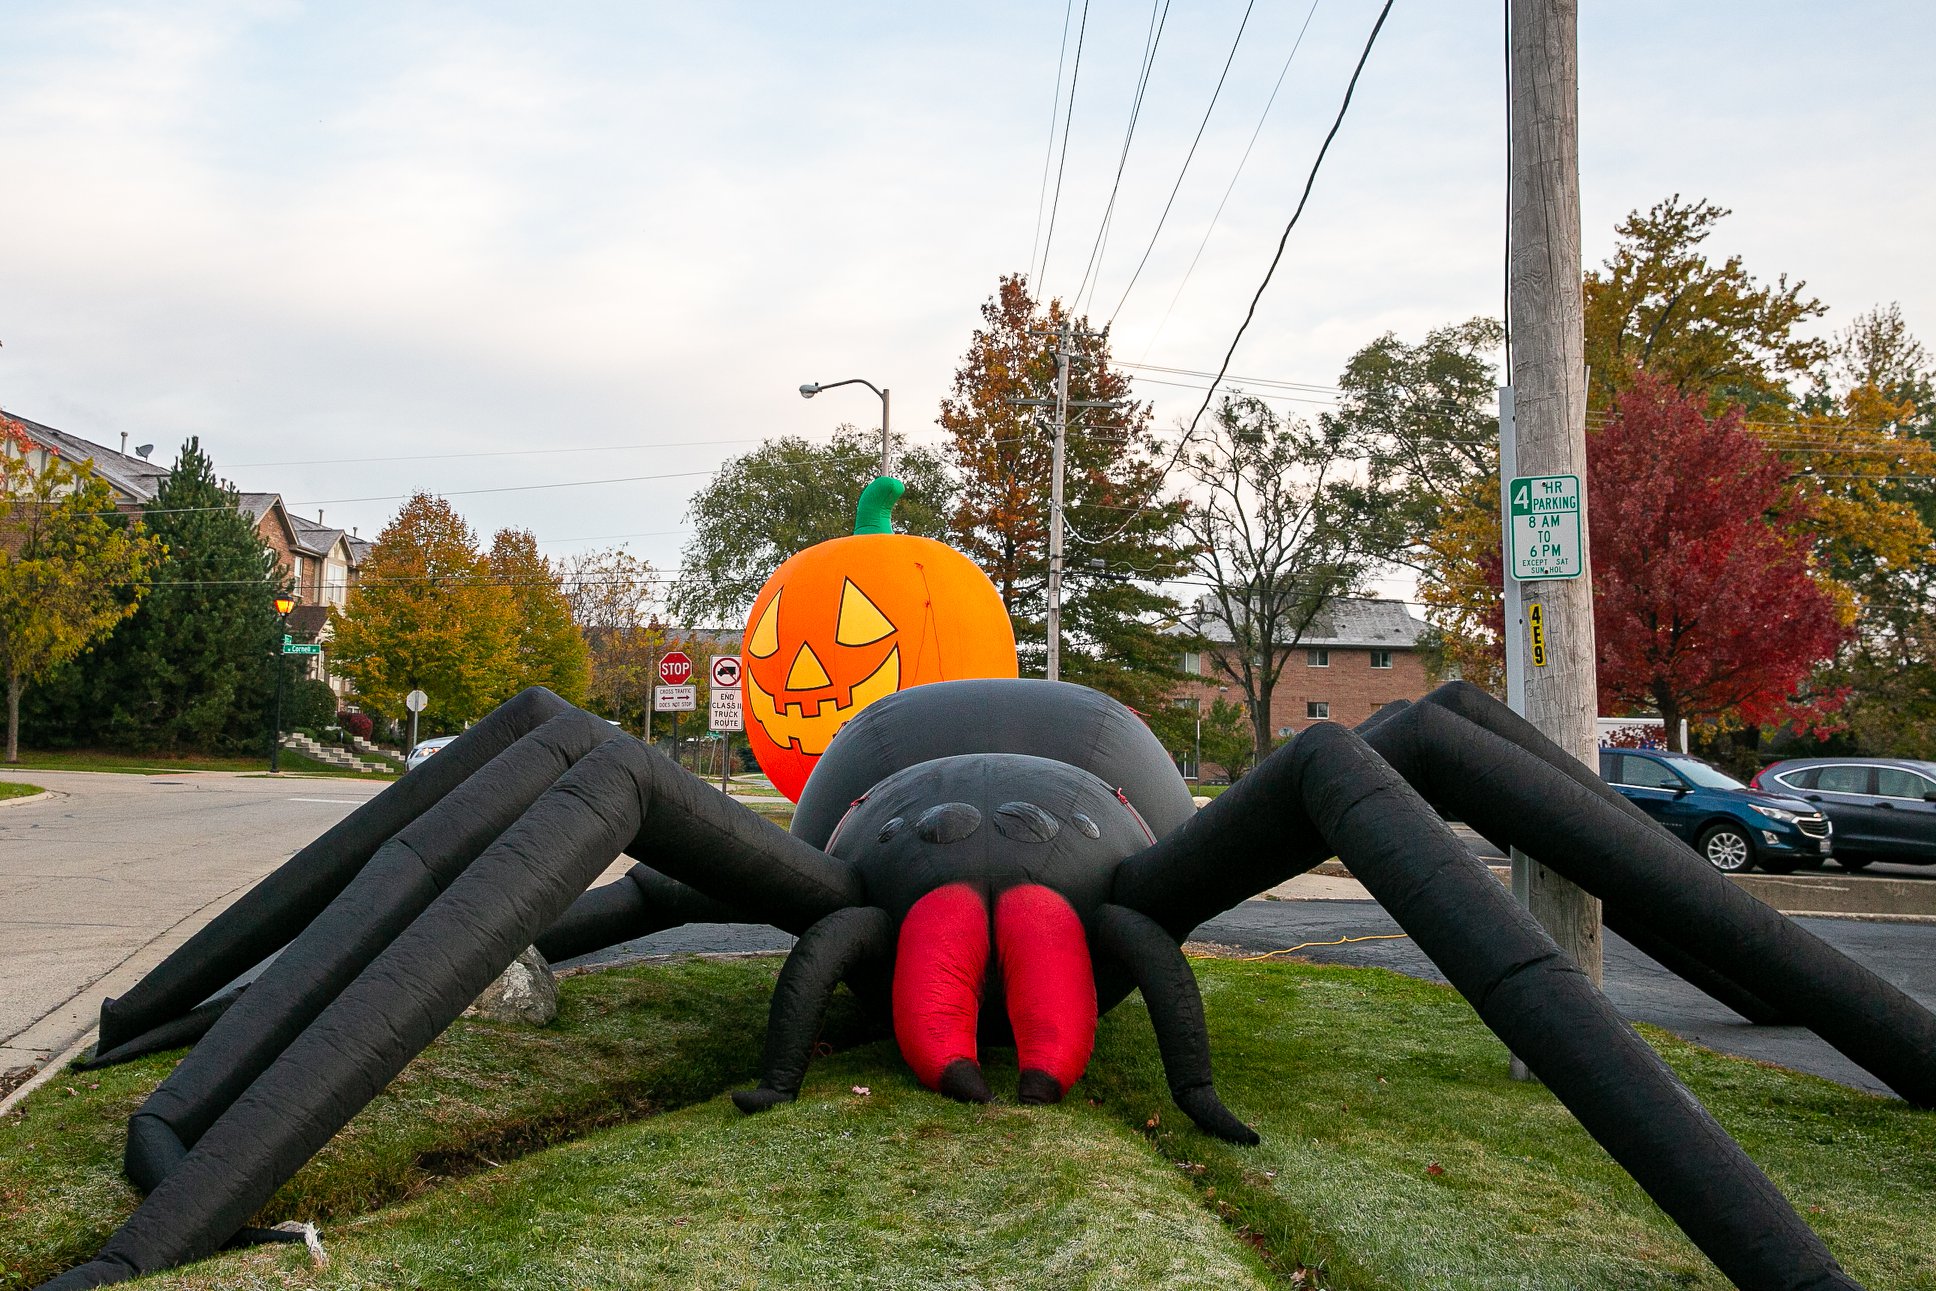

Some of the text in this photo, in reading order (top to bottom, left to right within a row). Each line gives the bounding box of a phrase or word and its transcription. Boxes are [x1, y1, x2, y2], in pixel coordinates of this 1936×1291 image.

[1513, 481, 1562, 510] 4 HR
[1533, 496, 1576, 511] PARKING
[1528, 515, 1560, 528] 8 AM
[1538, 530, 1551, 543] TO
[1530, 544, 1561, 558] 6 PM
[1522, 559, 1548, 567] EXCEPT
[661, 662, 690, 676] STOP
[720, 693, 735, 701] END
[714, 710, 738, 718] TRUCK
[714, 719, 739, 727] ROUTE
